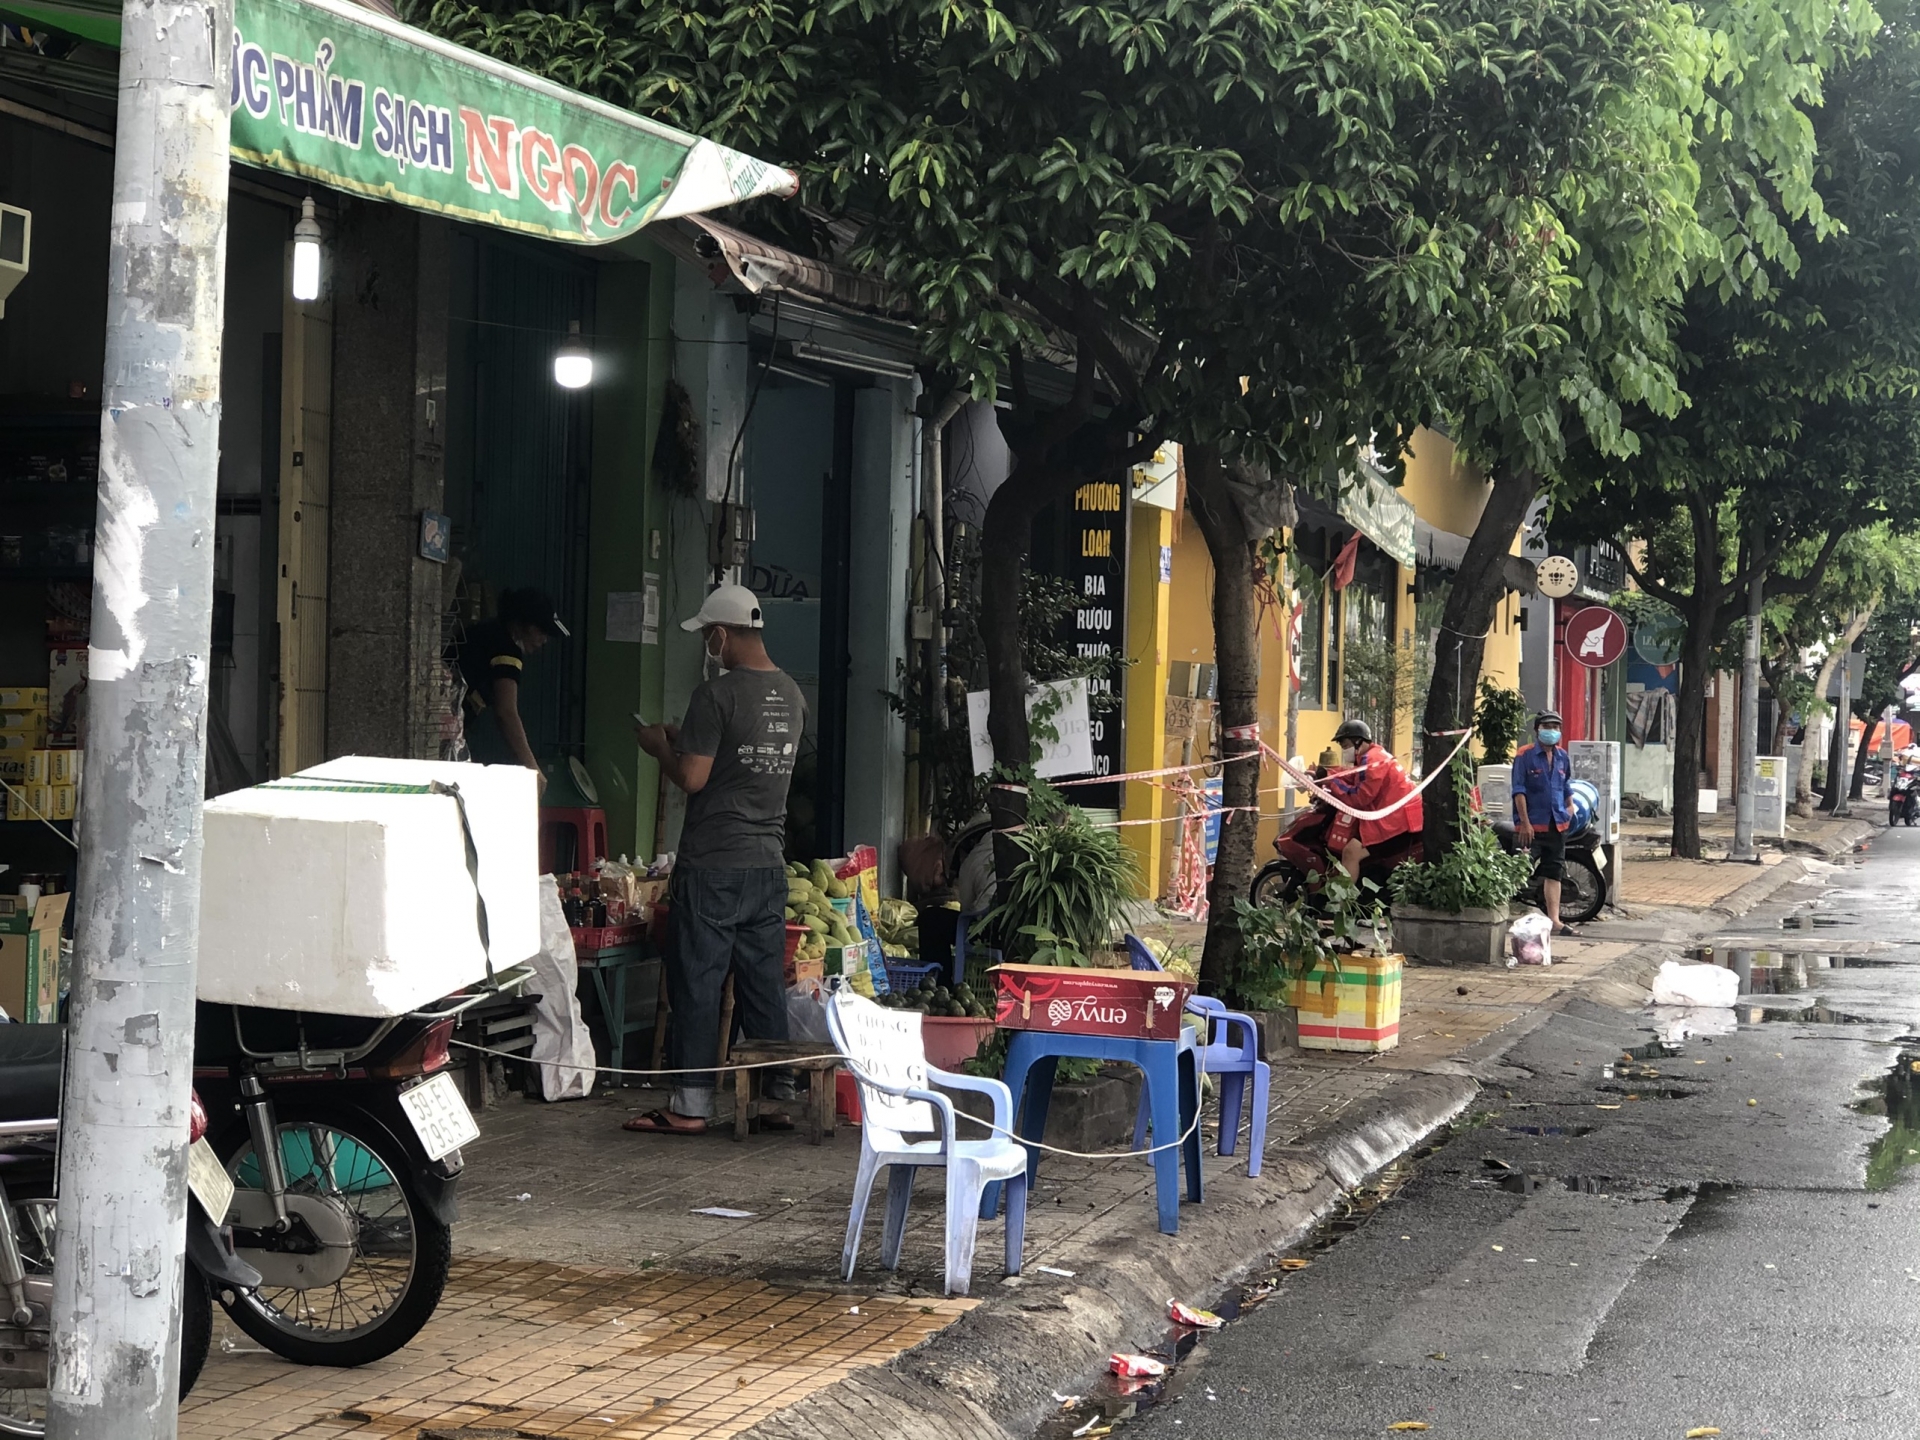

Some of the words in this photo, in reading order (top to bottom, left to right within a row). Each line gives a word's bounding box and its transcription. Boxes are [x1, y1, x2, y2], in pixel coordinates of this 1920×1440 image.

[271, 40, 364, 147] PHẨM
[374, 90, 452, 170] SẠCH
[459, 106, 638, 235] NGỌC
[1074, 481, 1121, 512] PHƯƠNG
[1081, 529, 1111, 558] LOAN
[1084, 575, 1106, 596] BIA
[1076, 606, 1113, 634] RƯỢU
[1071, 995, 1127, 1025] envy
